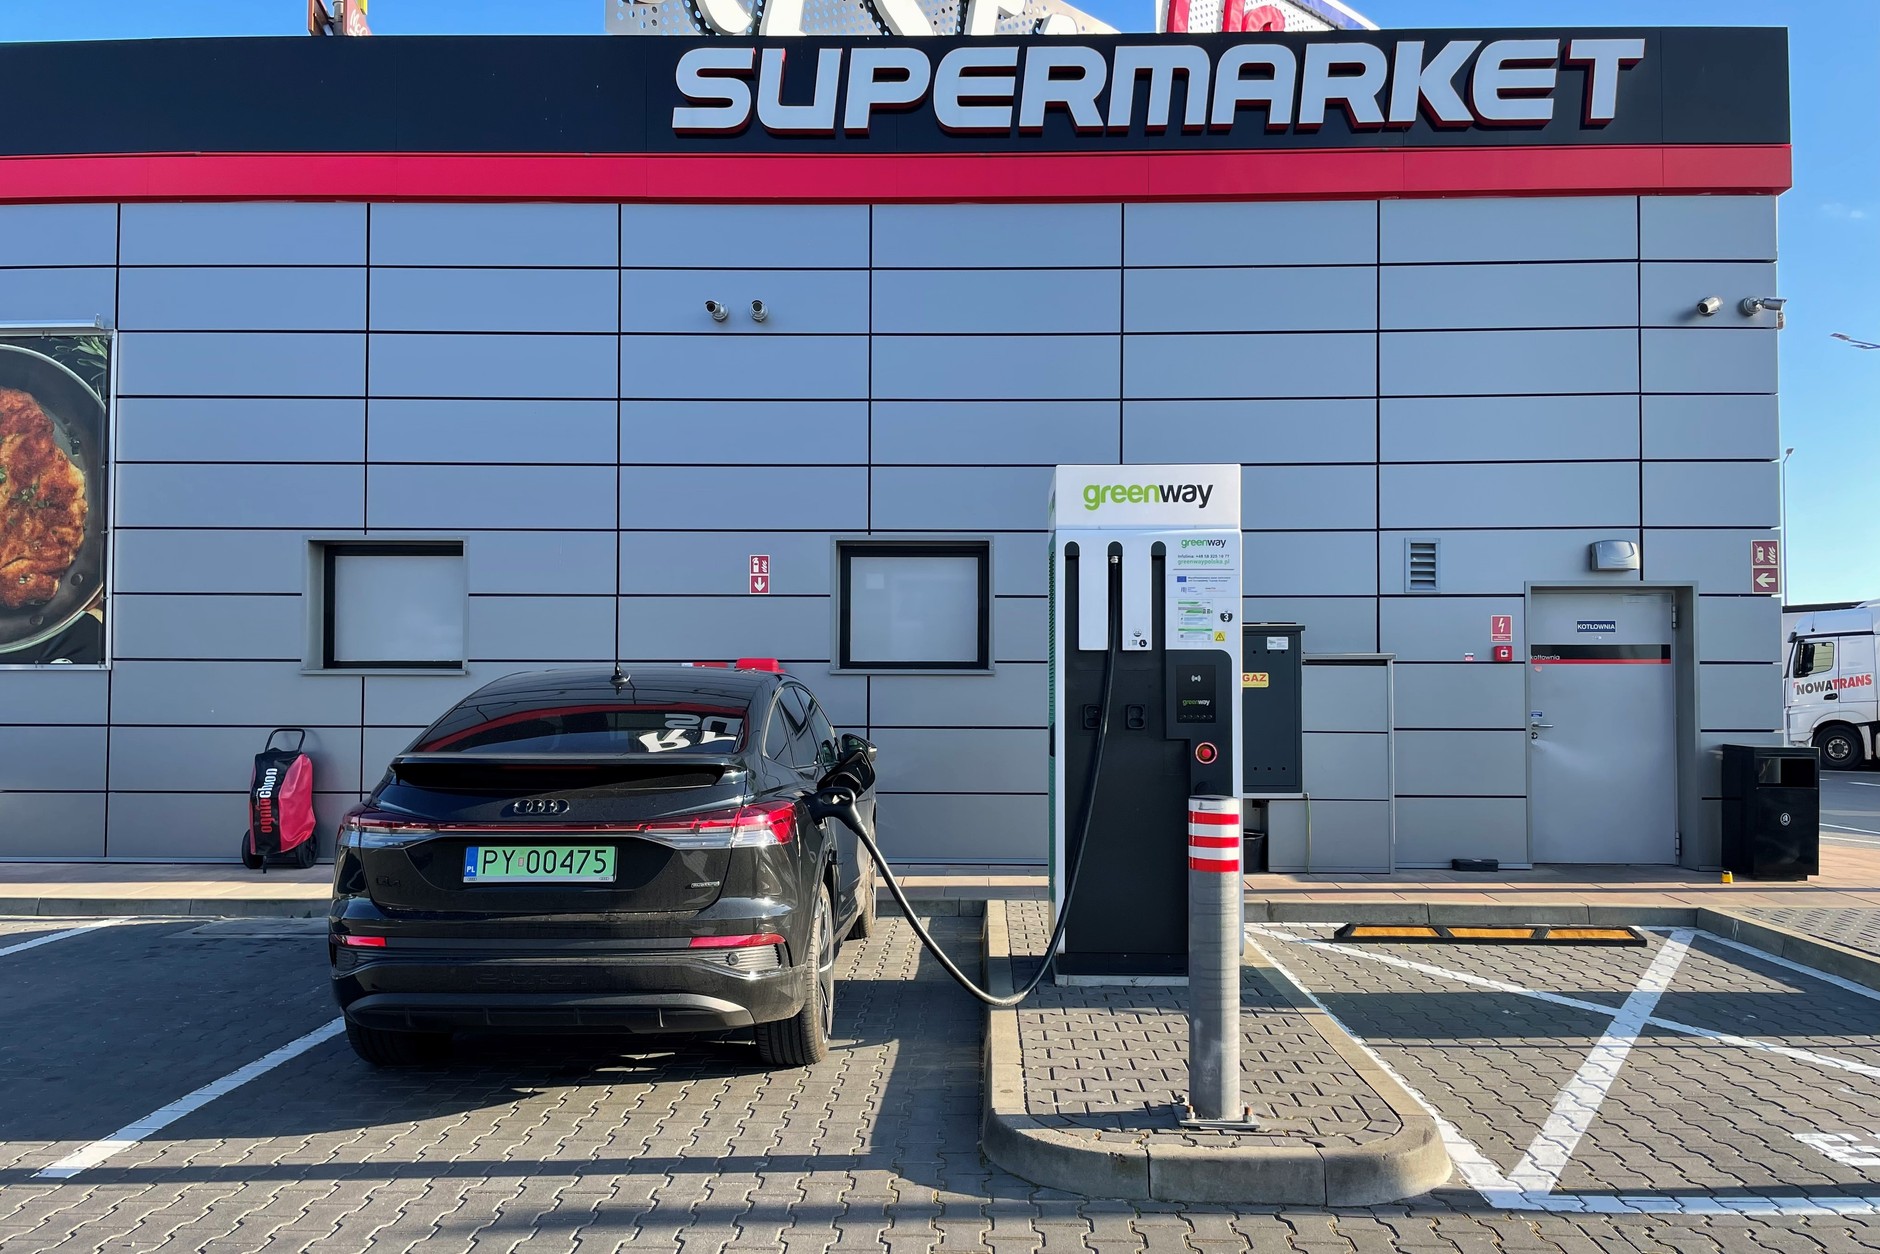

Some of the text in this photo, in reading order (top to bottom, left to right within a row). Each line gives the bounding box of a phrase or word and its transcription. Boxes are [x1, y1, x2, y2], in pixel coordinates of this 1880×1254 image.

[672, 36, 1646, 136] SUPERMARKET
[1083, 484, 1213, 511] greenway
[1181, 539, 1226, 549] greenway
[1223, 613, 1229, 621] 3
[1242, 674, 1267, 682] GAZ
[1796, 674, 1873, 695] NOWATRANS
[482, 850, 607, 874] PY 00475
